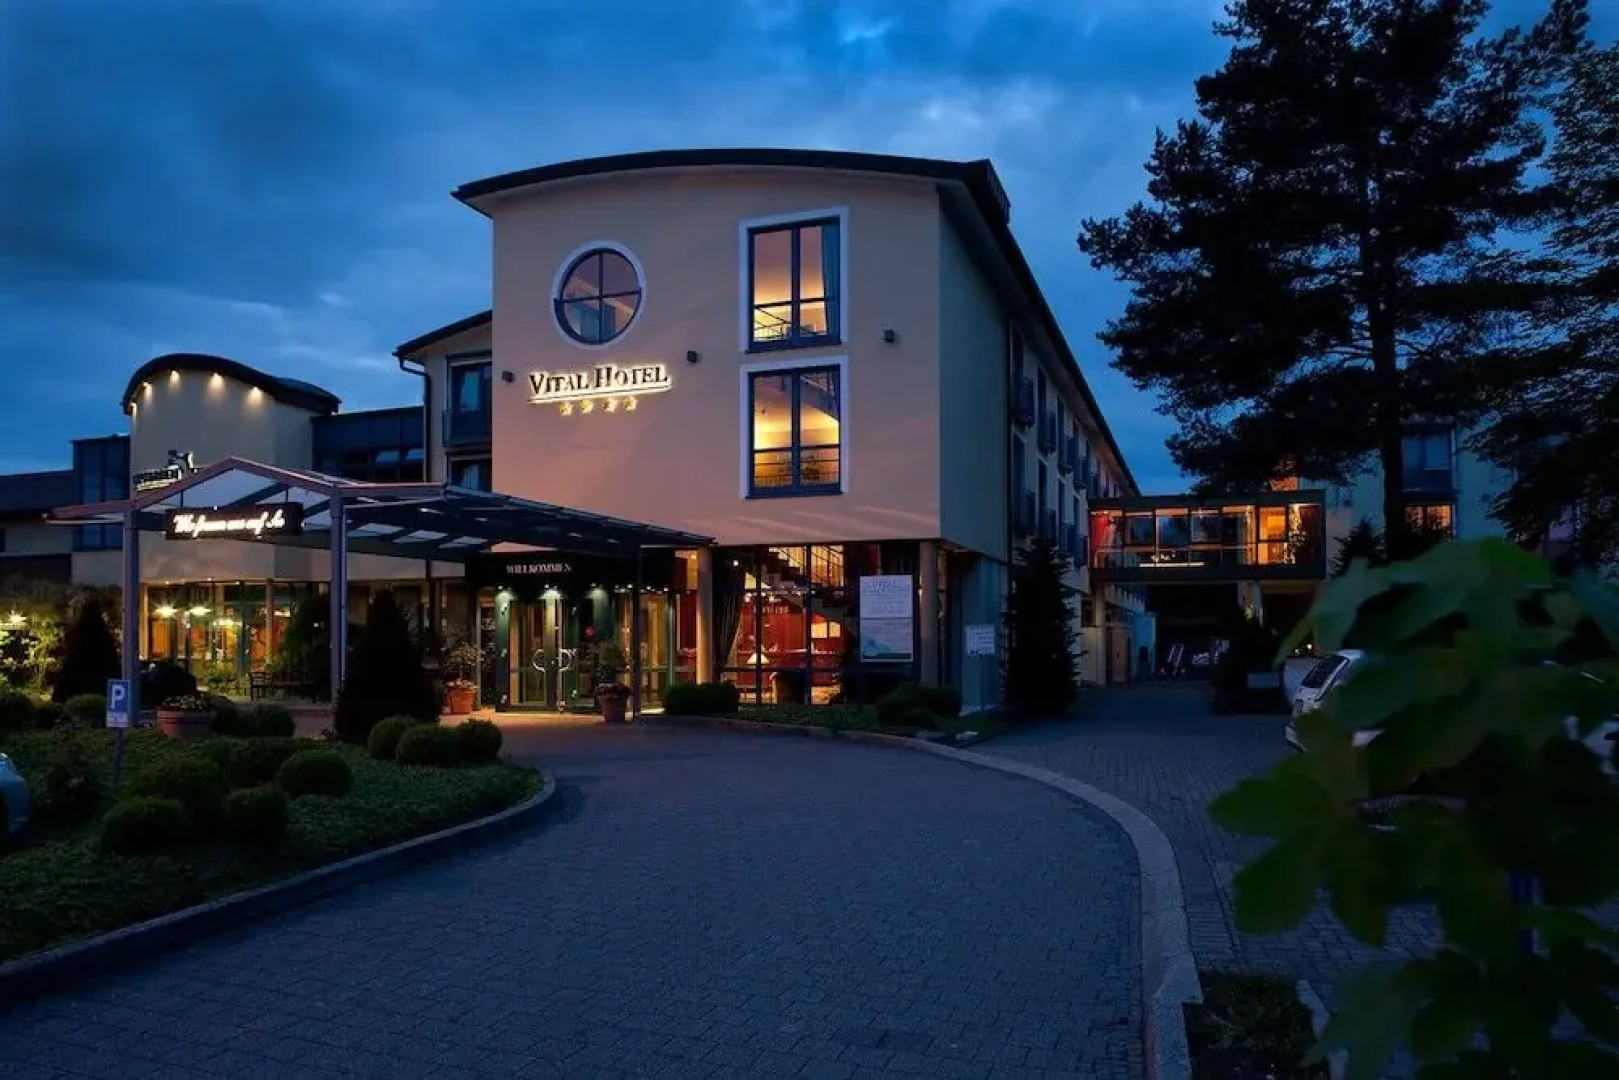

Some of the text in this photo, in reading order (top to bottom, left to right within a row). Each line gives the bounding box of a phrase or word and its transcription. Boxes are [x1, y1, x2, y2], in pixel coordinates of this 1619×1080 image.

[529, 366, 669, 395] VITAL HOTEL
[505, 563, 572, 575] WILLKOMMEN
[111, 684, 126, 710] P
